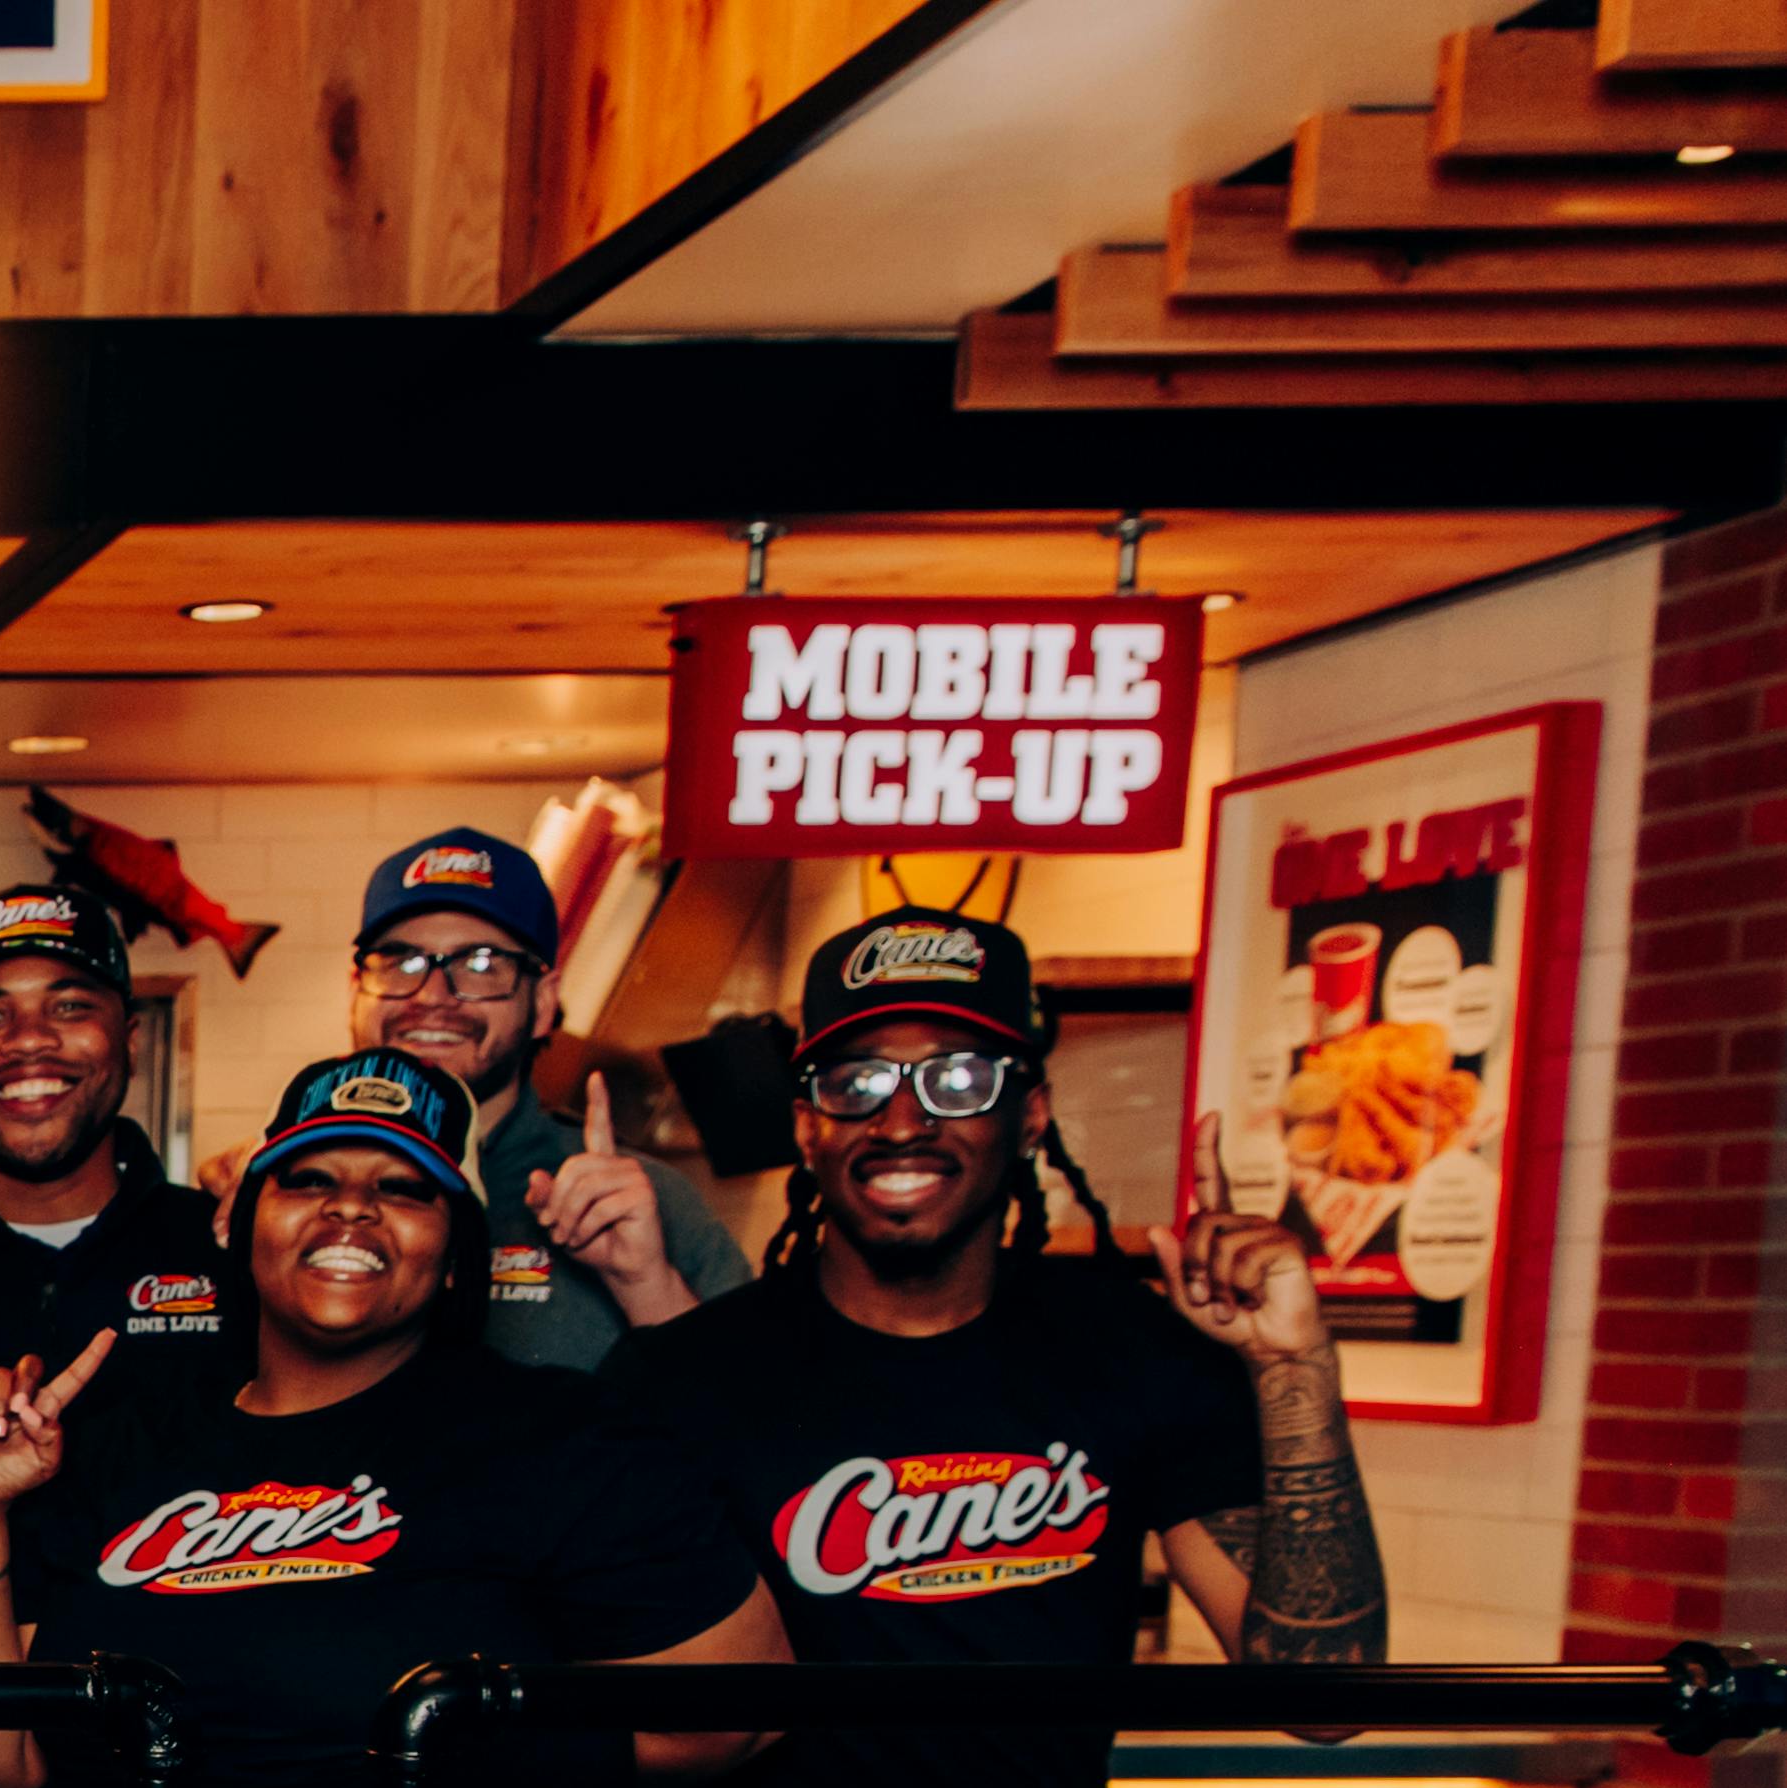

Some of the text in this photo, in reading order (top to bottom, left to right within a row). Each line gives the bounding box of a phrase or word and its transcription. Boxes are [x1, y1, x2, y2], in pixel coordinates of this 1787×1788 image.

[743, 623, 1164, 722] MOBILE
[728, 729, 1163, 827] PICK-UP
[842, 926, 985, 990] Cane's
[129, 1274, 216, 1311] Cane's
[127, 1315, 219, 1334] ONE LOVE
[897, 1456, 1012, 1489] Raising
[97, 1474, 403, 1586] Cane's
[786, 1441, 1110, 1595] Cane's
[179, 1563, 351, 1585] CHICKEN FINGERS
[900, 1570, 982, 1589] CHICKEN
